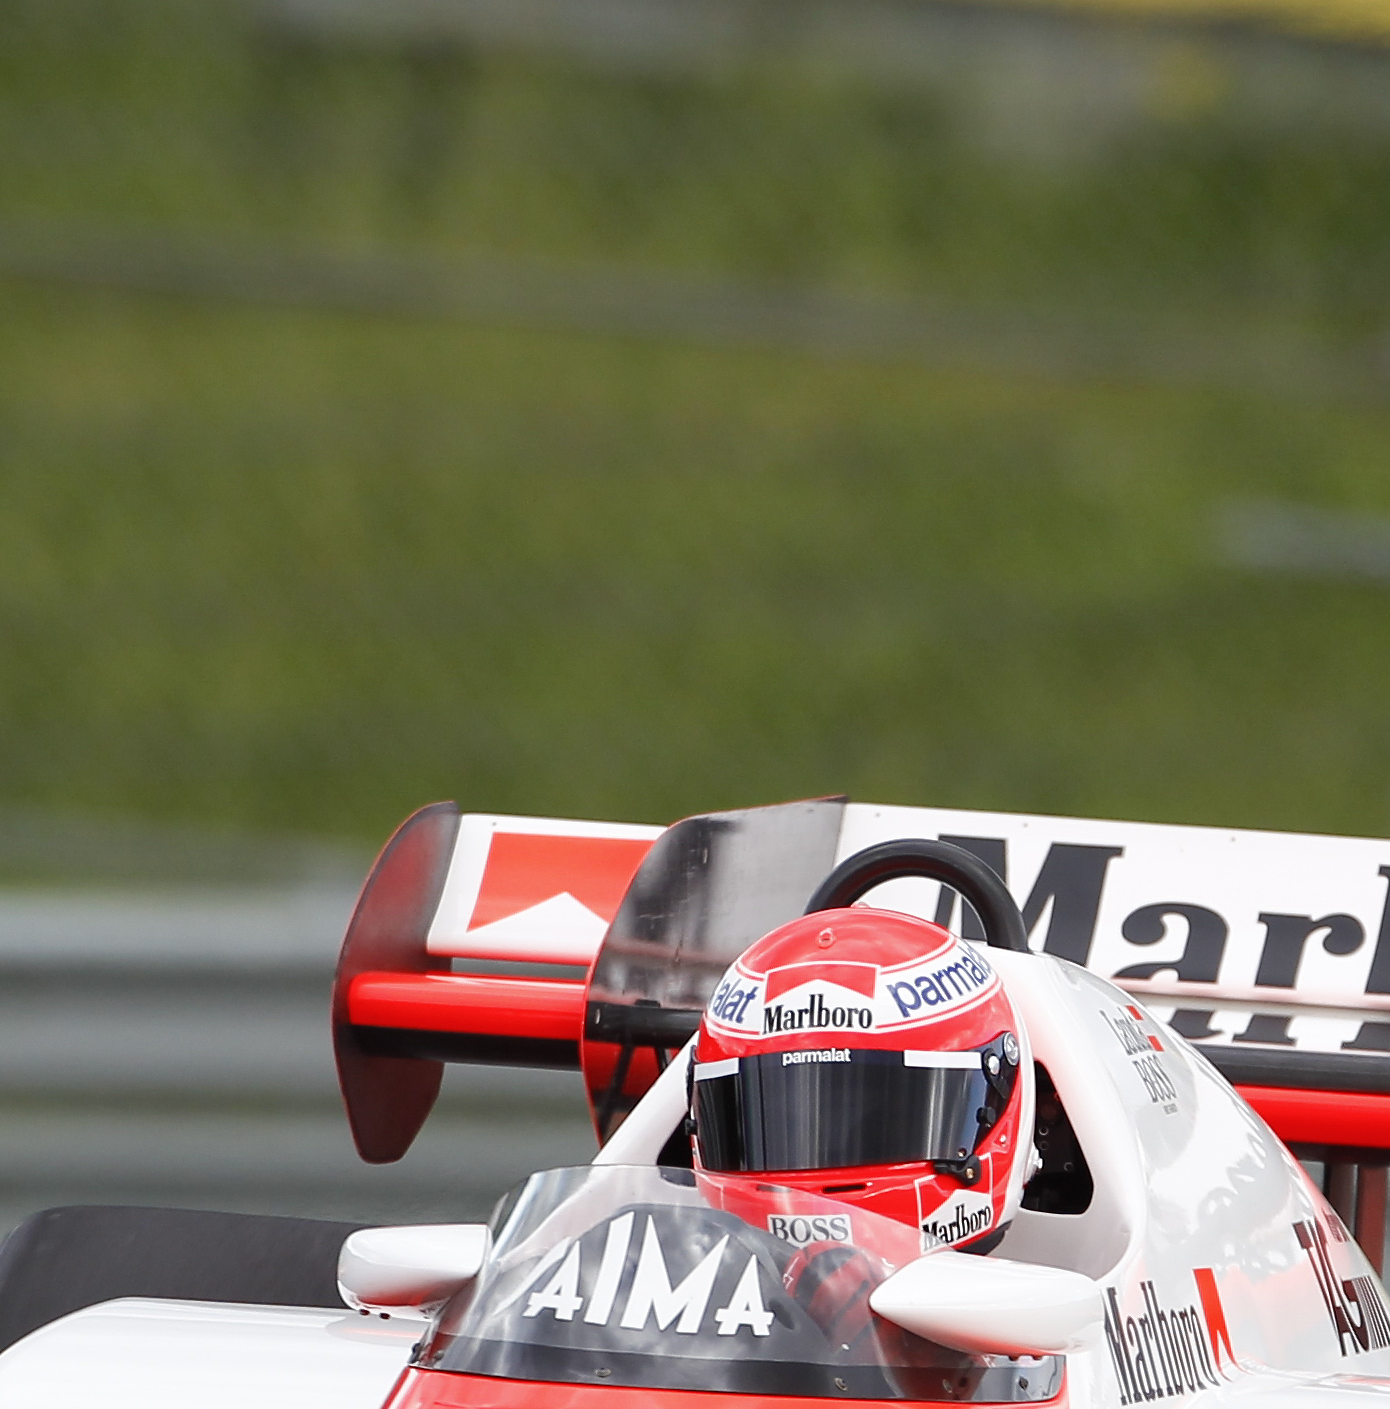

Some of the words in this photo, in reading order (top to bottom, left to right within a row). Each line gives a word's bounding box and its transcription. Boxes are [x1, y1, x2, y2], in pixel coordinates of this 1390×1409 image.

[762, 994, 872, 1035] Marlboro
[782, 1047, 852, 1066] parmalat
[1132, 1053, 1177, 1103] BOSS
[770, 1216, 849, 1243] BOSS
[922, 1203, 992, 1251] Marlboro
[1100, 1280, 1221, 1406] Marlboro
